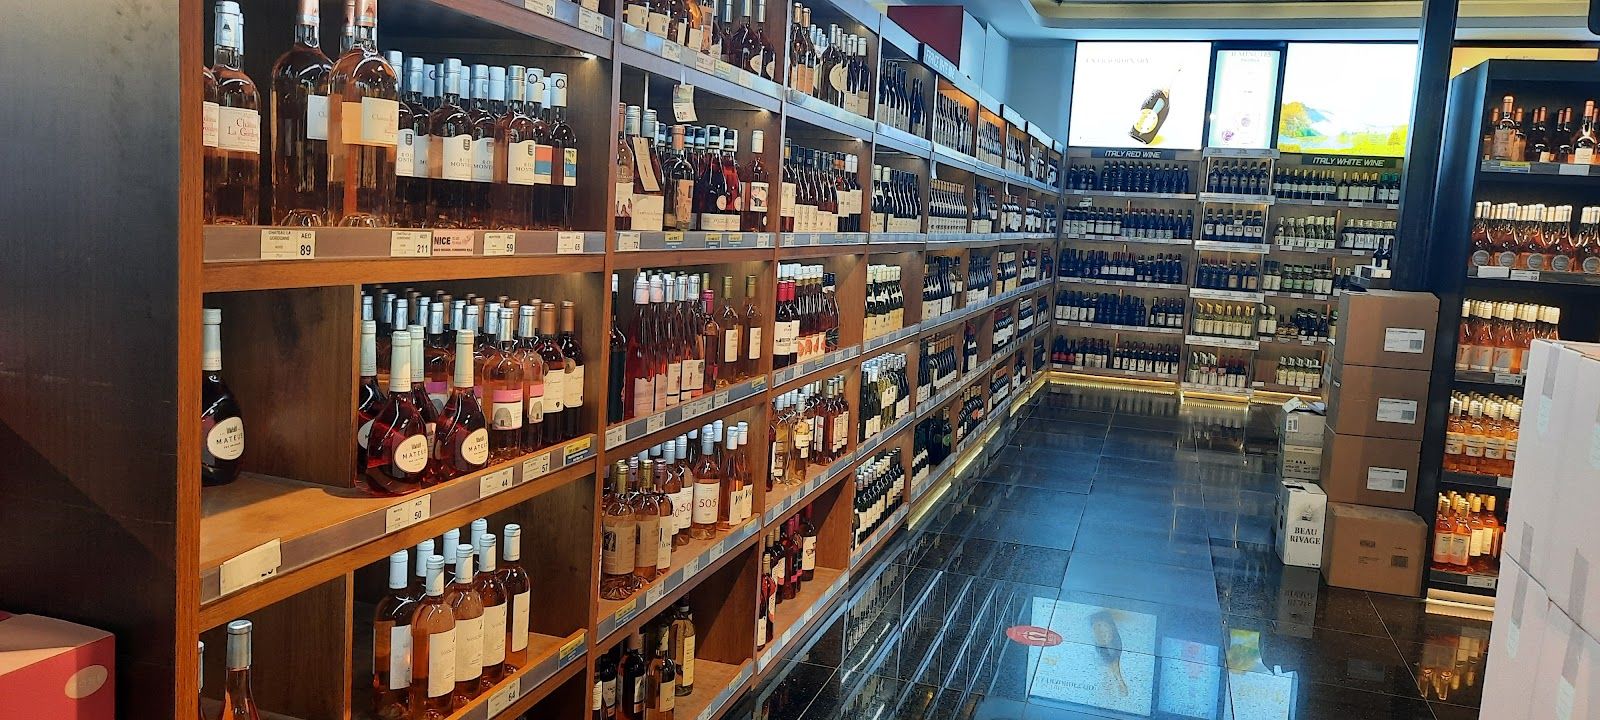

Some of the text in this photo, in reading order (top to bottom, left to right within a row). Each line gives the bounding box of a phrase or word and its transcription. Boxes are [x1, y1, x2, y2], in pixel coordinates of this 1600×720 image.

[1142, 151, 1161, 159] WINE
[1312, 157, 1385, 167] ITALY WHITE WINE
[434, 236, 451, 245] NICE
[301, 244, 311, 256] 89
[417, 244, 428, 254] 211
[506, 243, 514, 252] 59
[541, 463, 548, 473] 57
[501, 478, 508, 488] 44
[699, 498, 717, 508] 505
[414, 510, 422, 520] 50
[1294, 526, 1318, 536] BEAU
[1290, 535, 1321, 545] RIVAGE
